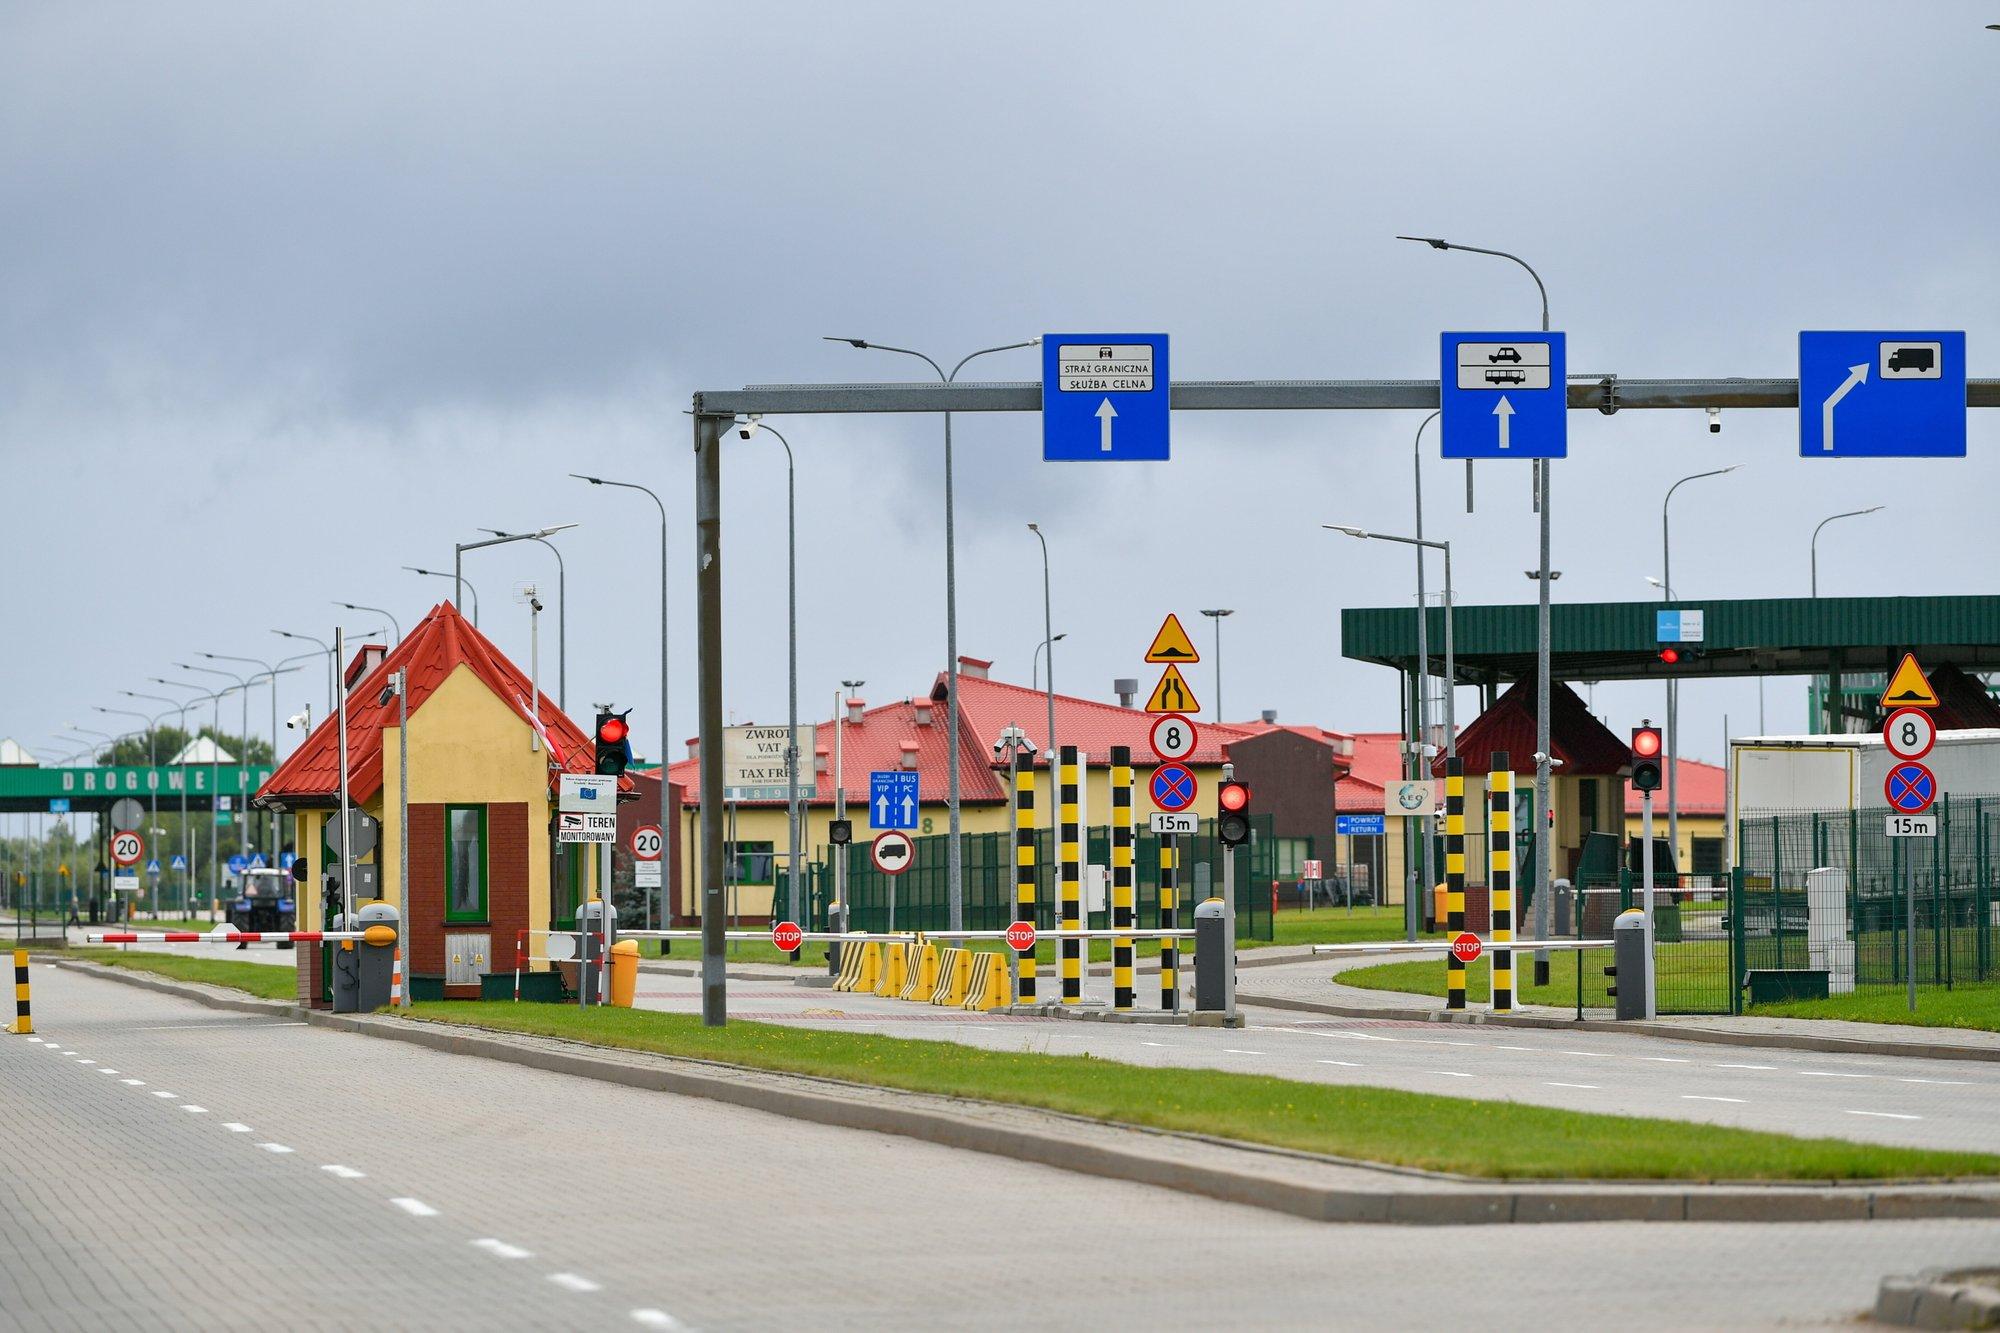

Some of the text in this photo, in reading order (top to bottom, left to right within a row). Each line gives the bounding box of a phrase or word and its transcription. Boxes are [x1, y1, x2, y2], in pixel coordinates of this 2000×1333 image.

[1065, 362, 1149, 373] STRAŻ GRANICZNA
[1070, 378, 1146, 389] SŁUŻBA CELNA
[745, 729, 790, 740] ZWROT
[1166, 726, 1181, 749] 8
[1902, 722, 1917, 746] 8
[757, 743, 782, 752] VAT
[739, 769, 764, 778] TAX
[900, 775, 916, 783] BUS
[63, 771, 205, 790] DROGOWE
[753, 789, 760, 798] 8
[774, 789, 781, 798] 9
[903, 785, 913, 793] PC
[588, 817, 615, 828] TEREN
[1158, 816, 1190, 830] 15m
[1351, 816, 1380, 824] POWRÓT
[922, 818, 933, 834] 8
[1894, 818, 1928, 834] 15m
[561, 832, 615, 841] MONITOROWANY
[117, 840, 138, 855] 20
[638, 835, 660, 851] 20
[775, 932, 799, 941] STOP
[1009, 931, 1033, 940] STOP
[1455, 943, 1480, 952] STOP
